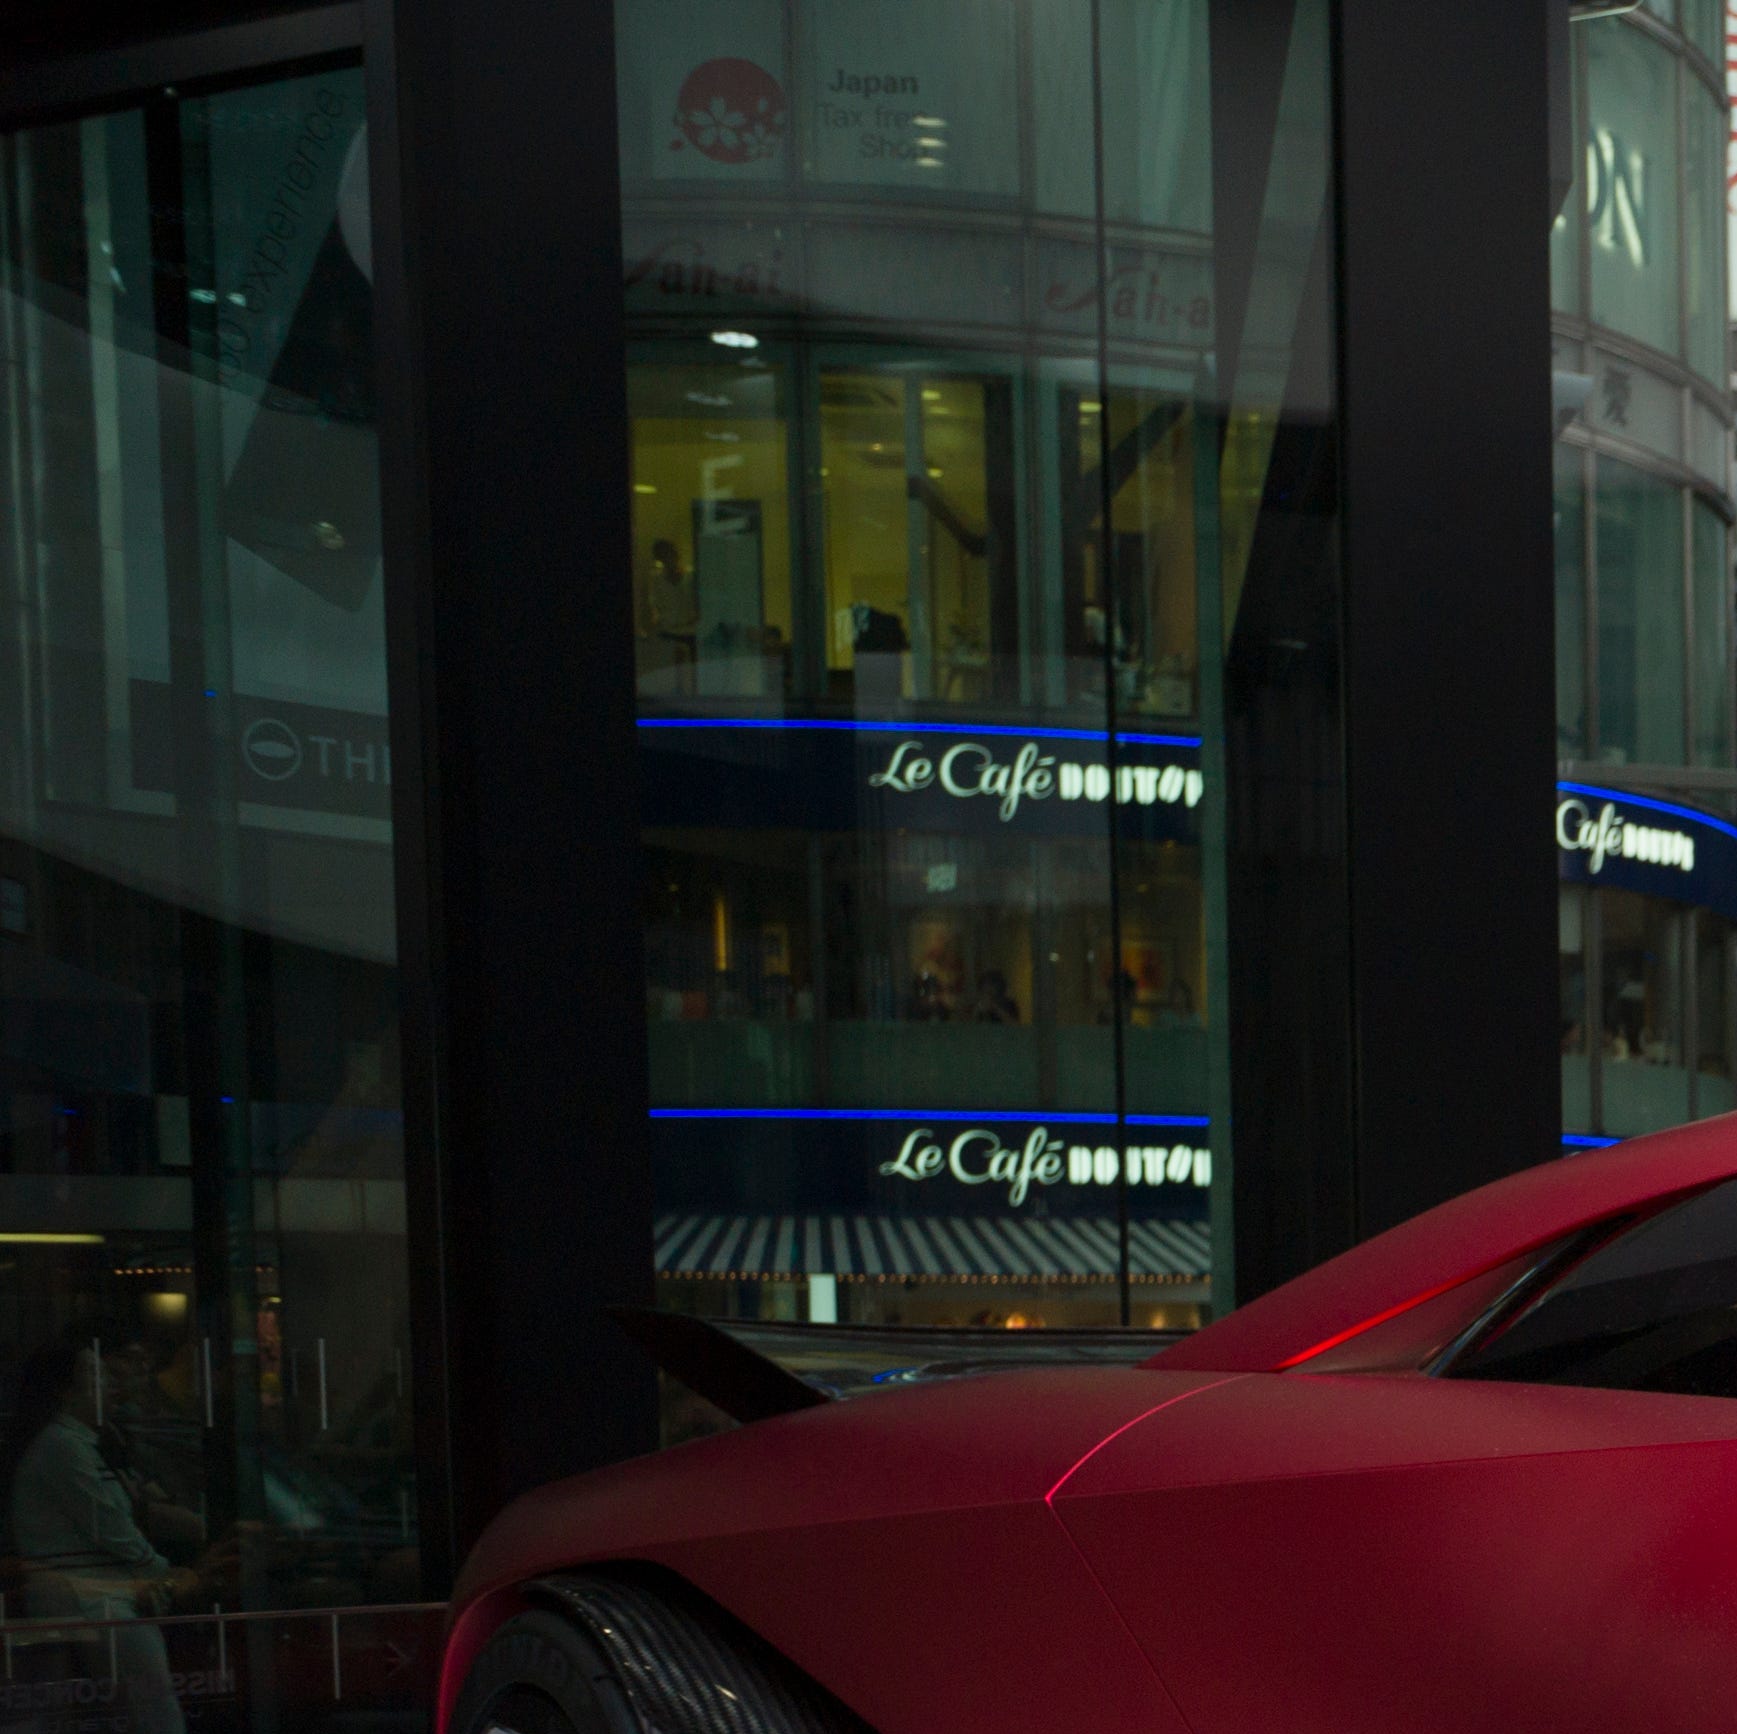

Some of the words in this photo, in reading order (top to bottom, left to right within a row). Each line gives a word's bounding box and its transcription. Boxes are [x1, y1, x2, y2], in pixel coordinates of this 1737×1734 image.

[828, 68, 920, 98] Japan
[868, 740, 936, 793] Le
[940, 742, 1056, 822] Café
[1556, 799, 1624, 875] Café
[880, 1128, 946, 1182] Le
[950, 1126, 1066, 1208] Café
